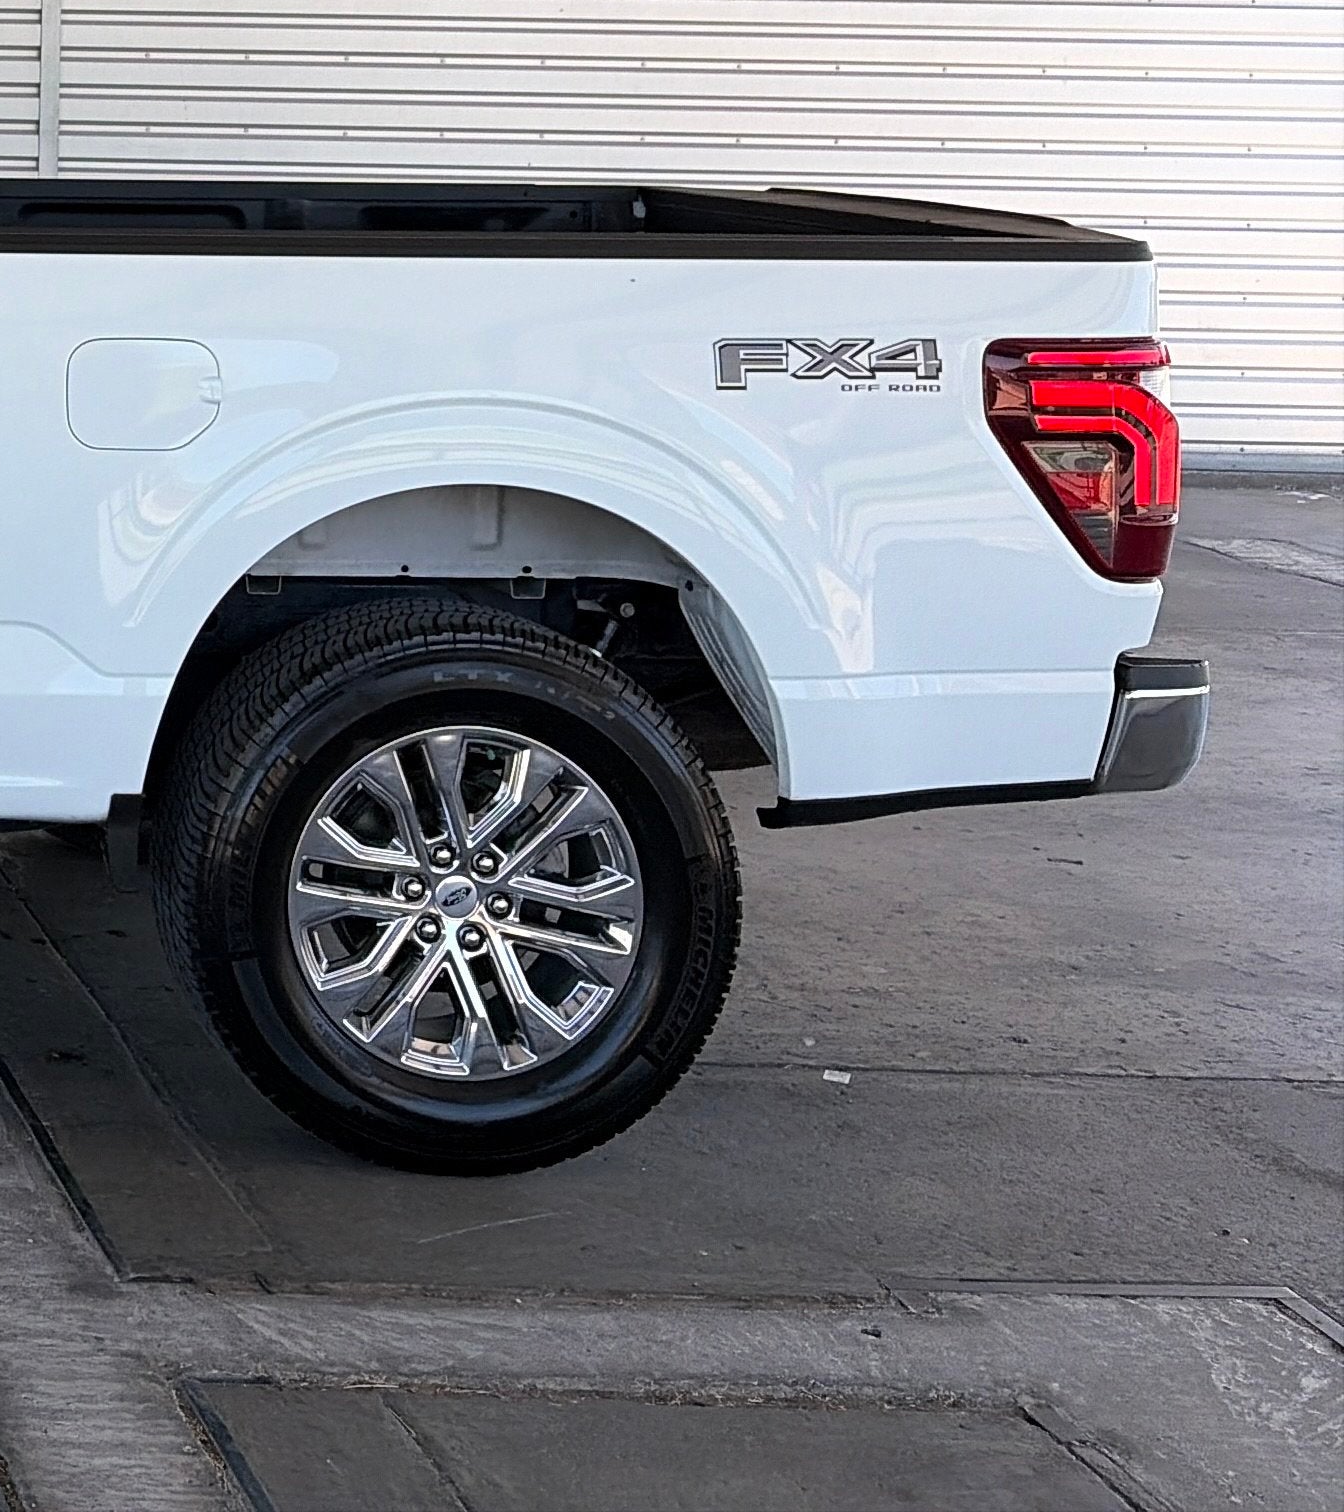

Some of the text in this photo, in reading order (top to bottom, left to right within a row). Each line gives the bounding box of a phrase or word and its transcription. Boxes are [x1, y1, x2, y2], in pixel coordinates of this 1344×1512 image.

[713, 338, 942, 390] FX4
[841, 384, 941, 393] OFF ROAD
